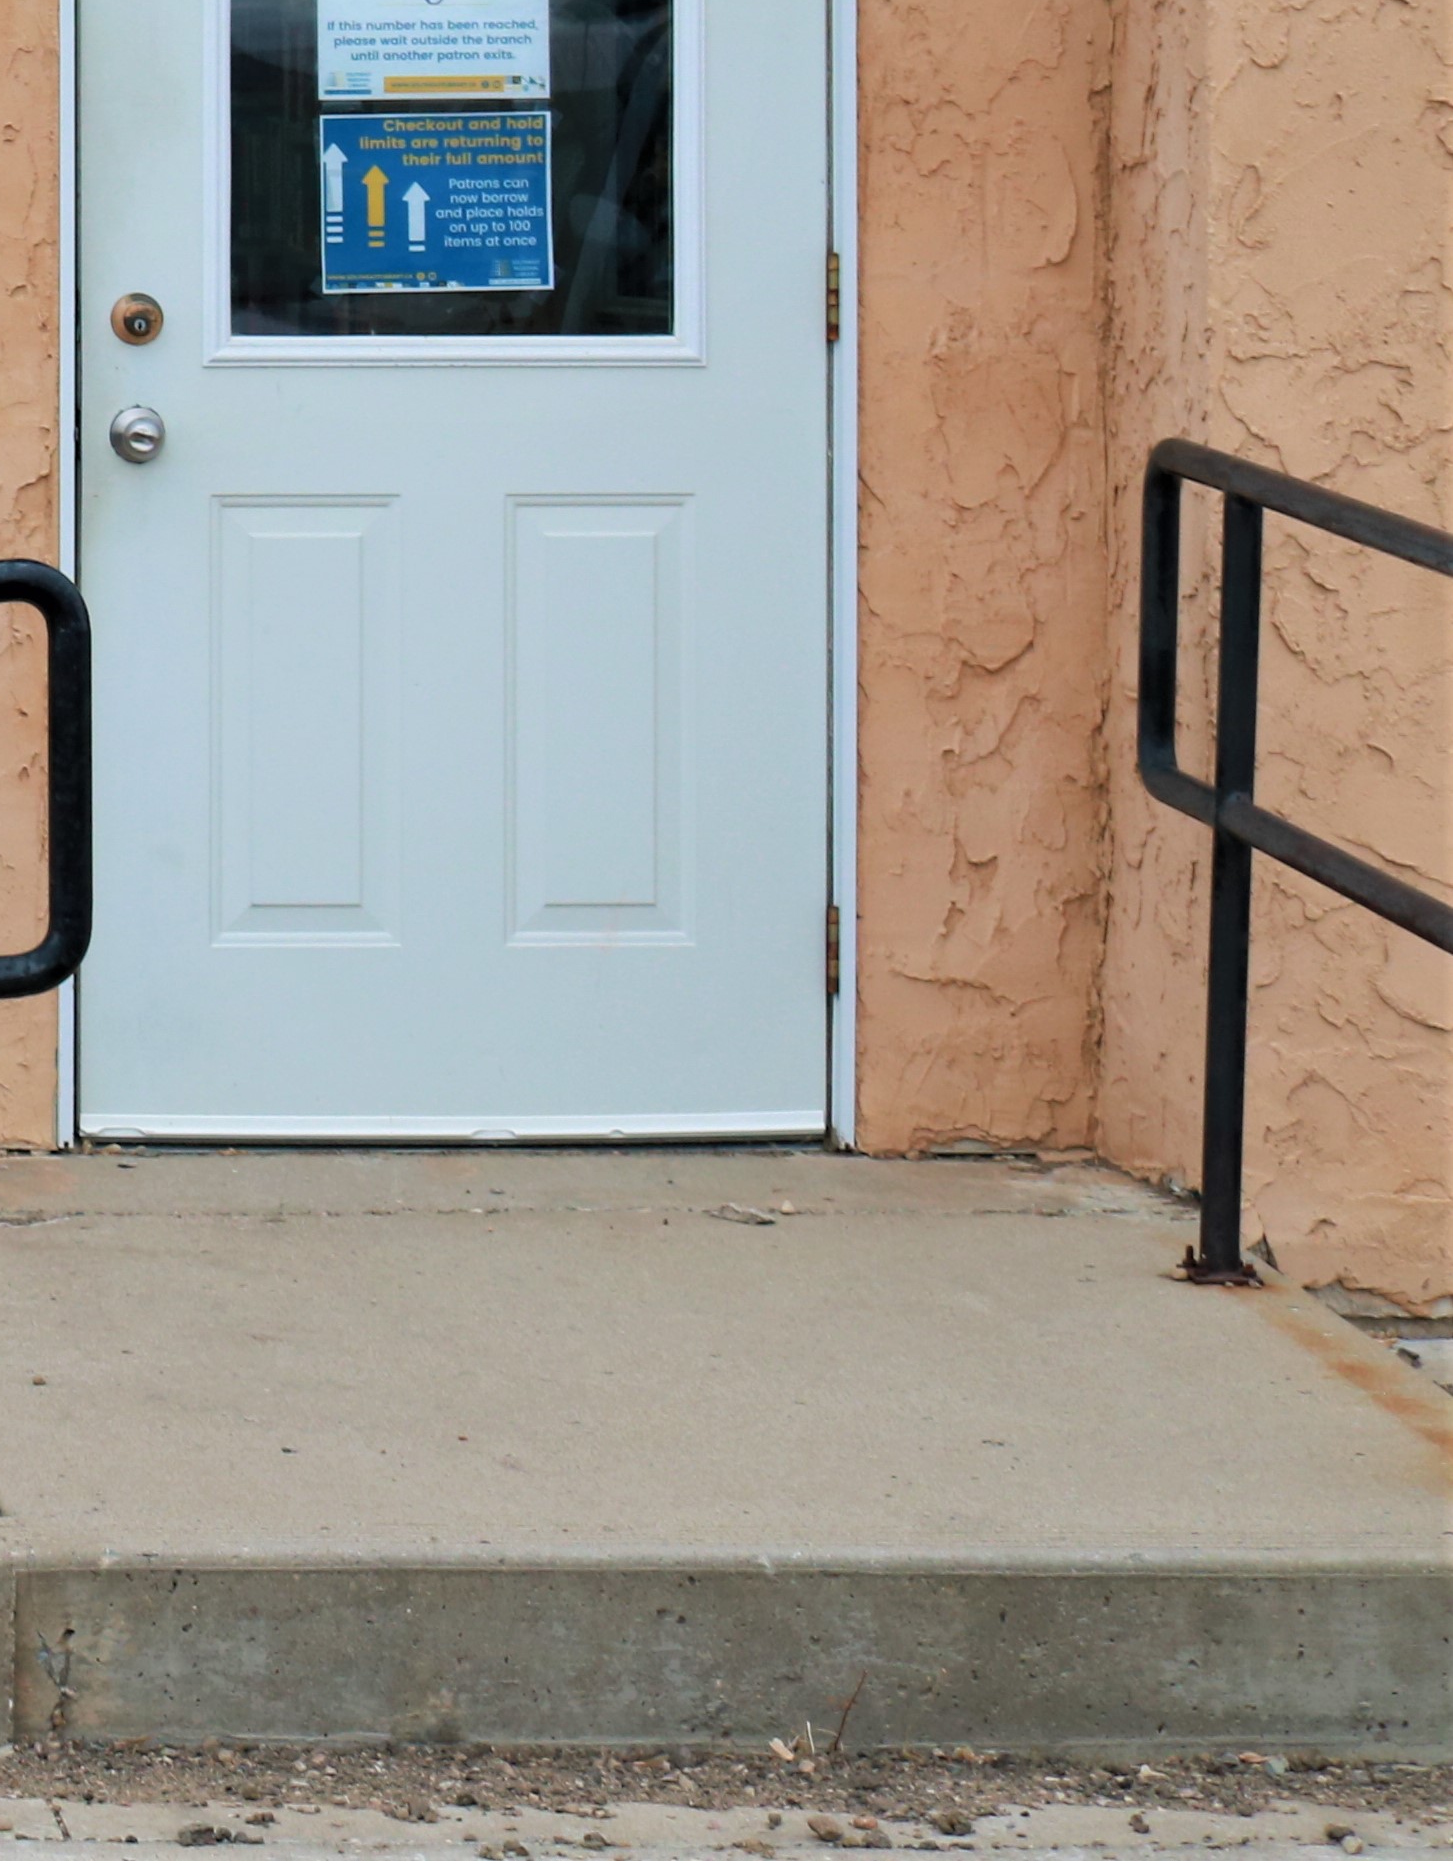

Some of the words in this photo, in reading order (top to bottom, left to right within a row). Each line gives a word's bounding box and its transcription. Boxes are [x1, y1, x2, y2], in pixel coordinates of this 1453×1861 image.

[328, 21, 334, 30] If
[339, 21, 361, 31] this
[366, 21, 416, 30] number
[421, 21, 442, 30] has
[448, 20, 479, 30] been
[484, 20, 538, 31] reached,
[334, 36, 376, 48] please
[381, 36, 407, 45] wait
[411, 36, 458, 45] outside
[462, 35, 481, 45] the
[487, 35, 532, 45] branch
[351, 51, 378, 61] until
[384, 51, 432, 61] another
[438, 51, 479, 62] patron
[484, 51, 515, 60] exits.
[384, 119, 462, 131] Checkout
[469, 118, 500, 130] and
[507, 117, 543, 129] hold
[360, 137, 405, 149] limits
[411, 138, 438, 149] are
[443, 135, 521, 151] returning
[527, 135, 543, 146] to
[403, 154, 440, 166] their
[446, 153, 471, 165] full
[477, 152, 543, 164] amount
[449, 179, 499, 189] Patrons
[504, 179, 529, 188] can
[450, 194, 478, 203] now
[482, 192, 528, 203] borrow
[436, 208, 462, 218] and
[467, 208, 503, 220] place
[508, 207, 544, 217] holds
[449, 222, 466, 232] on
[470, 223, 488, 235] up
[492, 222, 505, 232] to
[509, 221, 530, 231] 100
[444, 236, 481, 247] items
[486, 237, 500, 246] at
[504, 236, 536, 246] once
